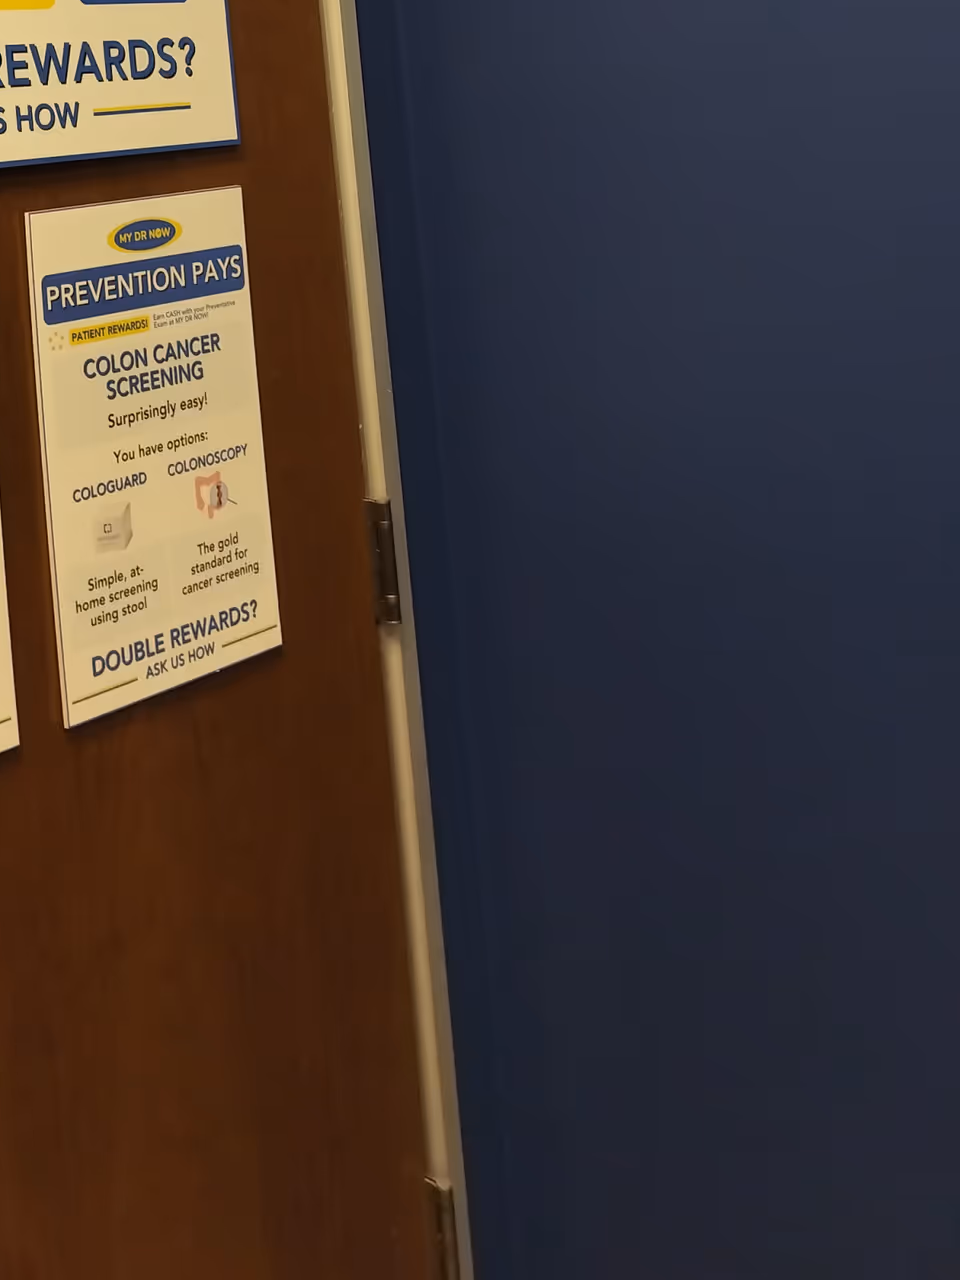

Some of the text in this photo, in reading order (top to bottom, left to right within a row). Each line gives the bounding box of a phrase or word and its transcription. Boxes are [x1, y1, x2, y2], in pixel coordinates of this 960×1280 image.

[15, 101, 79, 132] HOW
[119, 227, 170, 243] MY DR NOW
[46, 254, 241, 310] PREVENTION PAYS
[71, 319, 148, 342] PATIENT REWARDS!
[83, 332, 221, 379] COLON CANCER
[106, 360, 204, 400] SCREENING
[107, 391, 207, 428] Surprisingly easy!
[112, 431, 208, 463] You have options:
[167, 443, 247, 476] COLONOSCOPY
[72, 471, 147, 503] COLOGUARD
[196, 531, 238, 555] The gold
[190, 547, 248, 575] standard for
[87, 565, 144, 591] Simple, at-
[181, 561, 259, 595] cancer screening
[75, 578, 158, 614] home screening
[90, 595, 147, 626] using stool
[91, 599, 257, 677] DOUBLE REWARDS?
[145, 641, 215, 679] ASK US HOW
